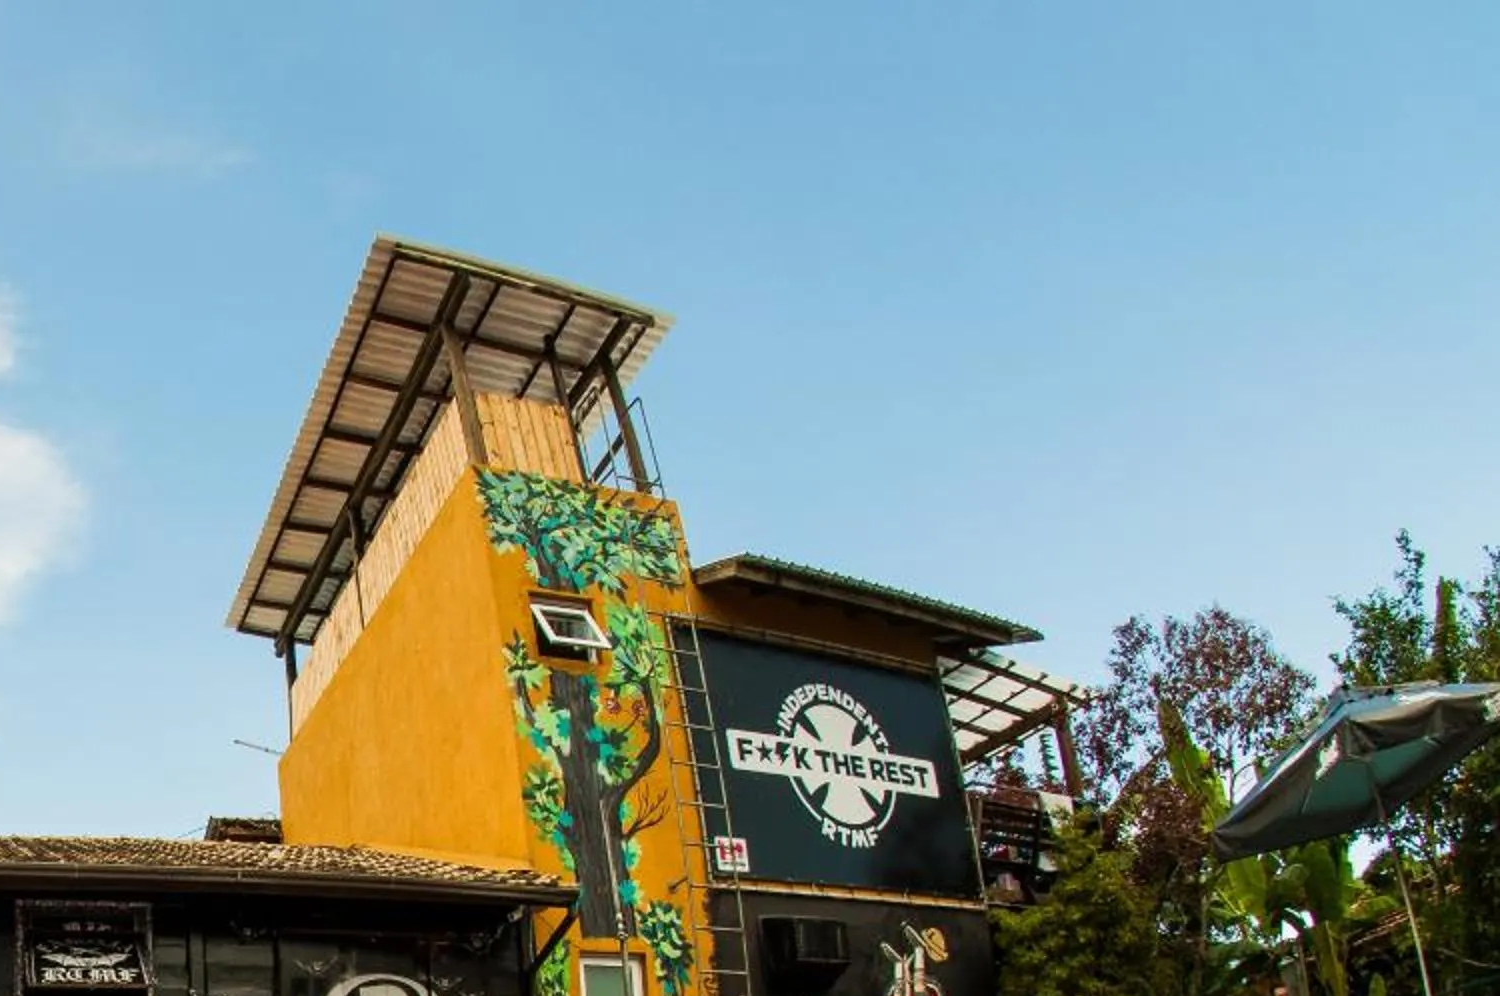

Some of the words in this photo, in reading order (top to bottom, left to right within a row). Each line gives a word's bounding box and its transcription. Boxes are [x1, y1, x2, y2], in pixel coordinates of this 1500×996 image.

[777, 683, 890, 752] INDEPENDENT
[814, 749, 866, 778] THE
[868, 757, 929, 789] REST
[821, 817, 880, 848] RTMF
